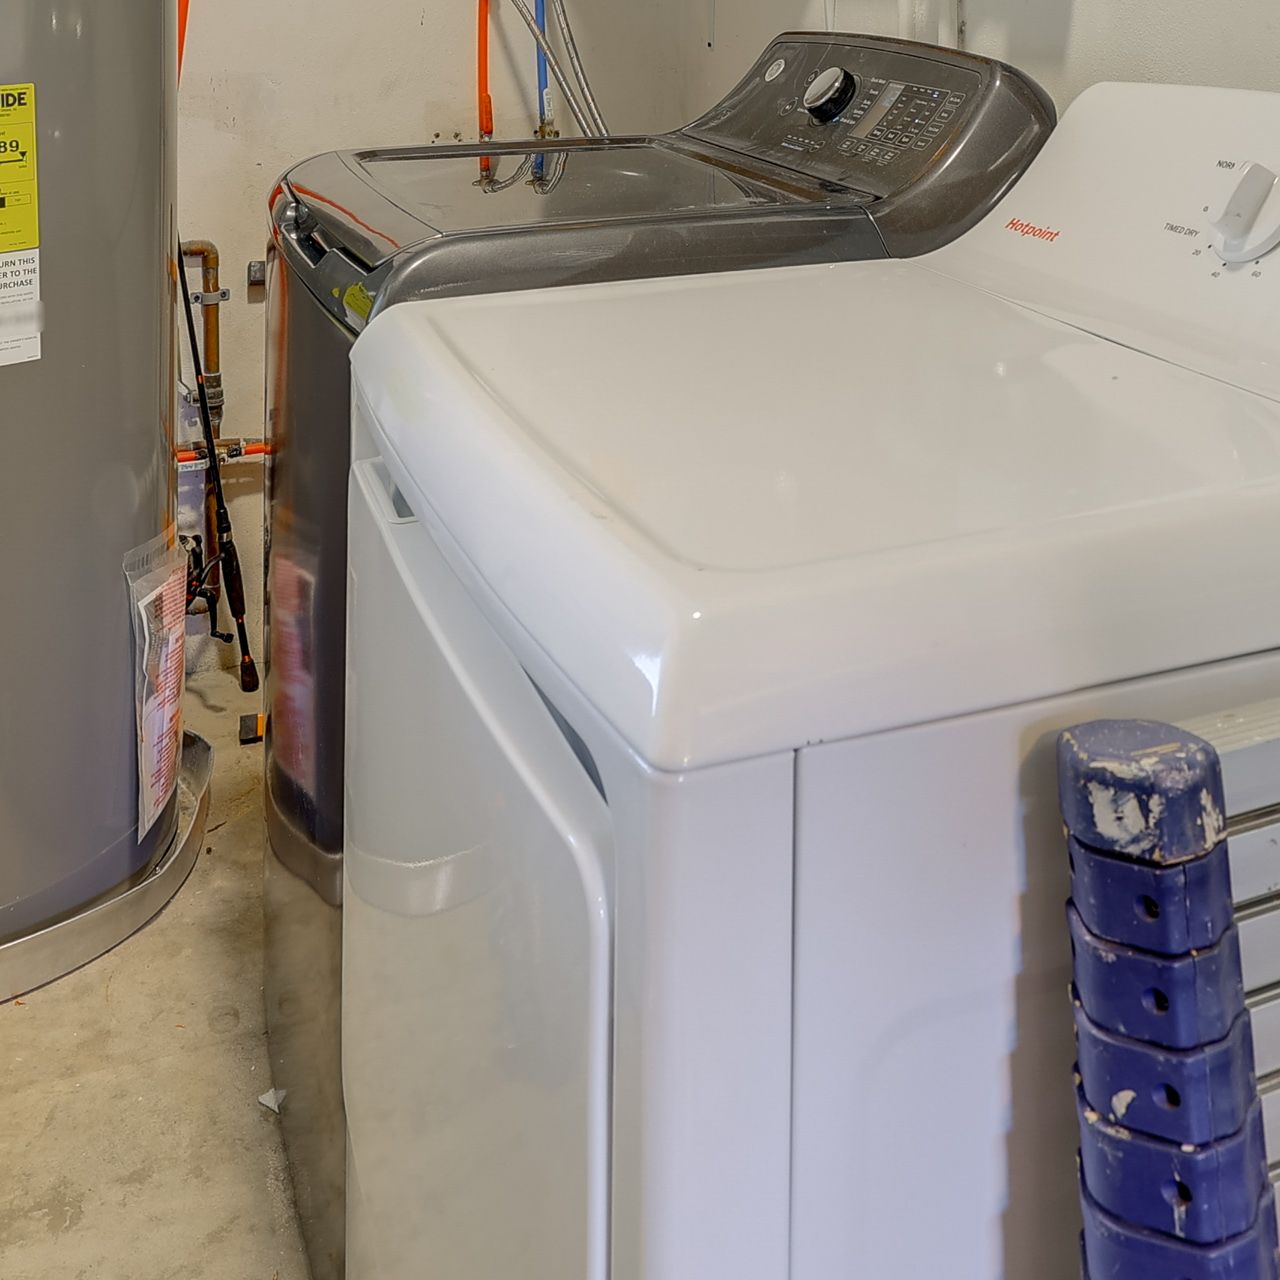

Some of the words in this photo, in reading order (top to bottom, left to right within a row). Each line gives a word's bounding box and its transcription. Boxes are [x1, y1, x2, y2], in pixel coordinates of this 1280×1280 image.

[1004, 218, 1060, 242] Hotpoint
[1164, 223, 1184, 235] TIMED
[1184, 228, 1200, 237] DRY
[18, 257, 35, 265] THIS
[23, 267, 37, 275] THE
